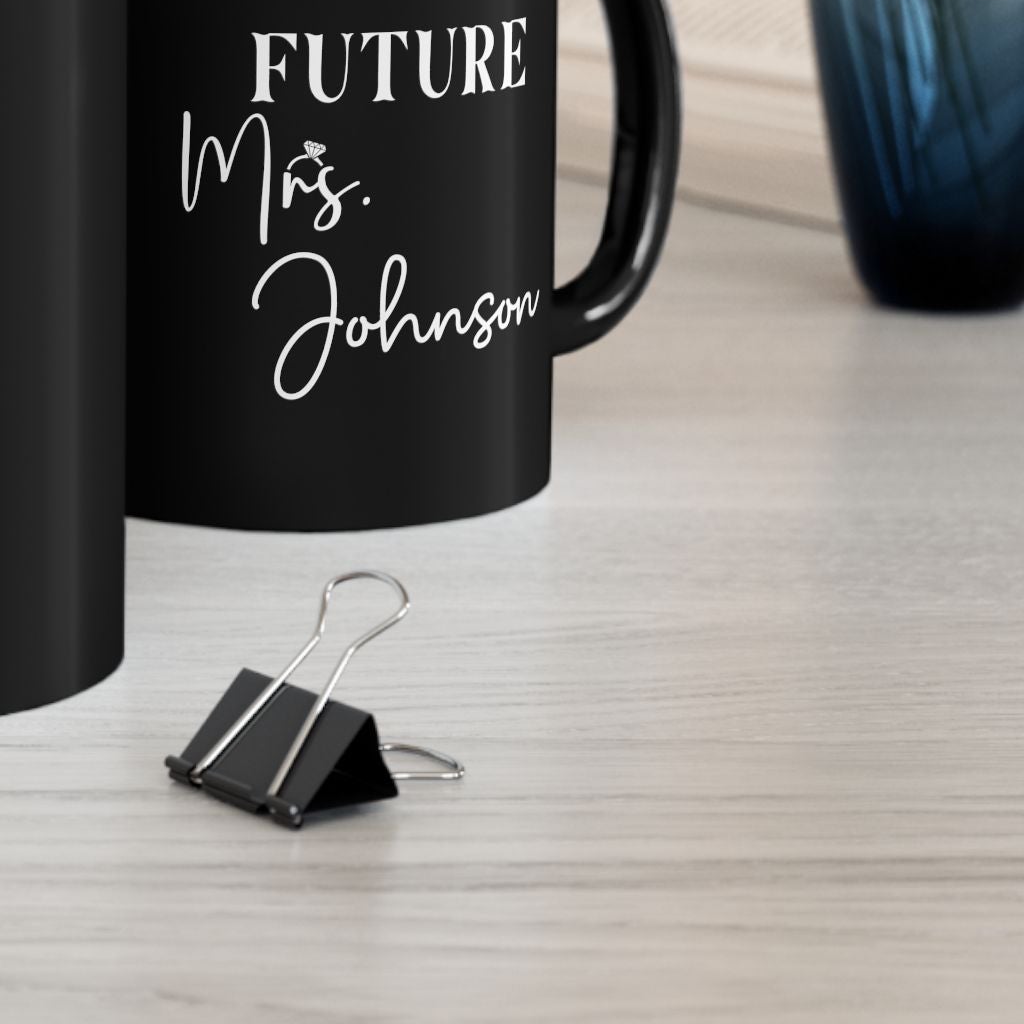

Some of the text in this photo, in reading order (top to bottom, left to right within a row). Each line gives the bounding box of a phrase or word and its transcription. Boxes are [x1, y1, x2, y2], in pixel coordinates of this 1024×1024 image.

[250, 16, 527, 104] FUTURE
[181, 110, 371, 246] Mrs.
[251, 251, 540, 401] Johnson
